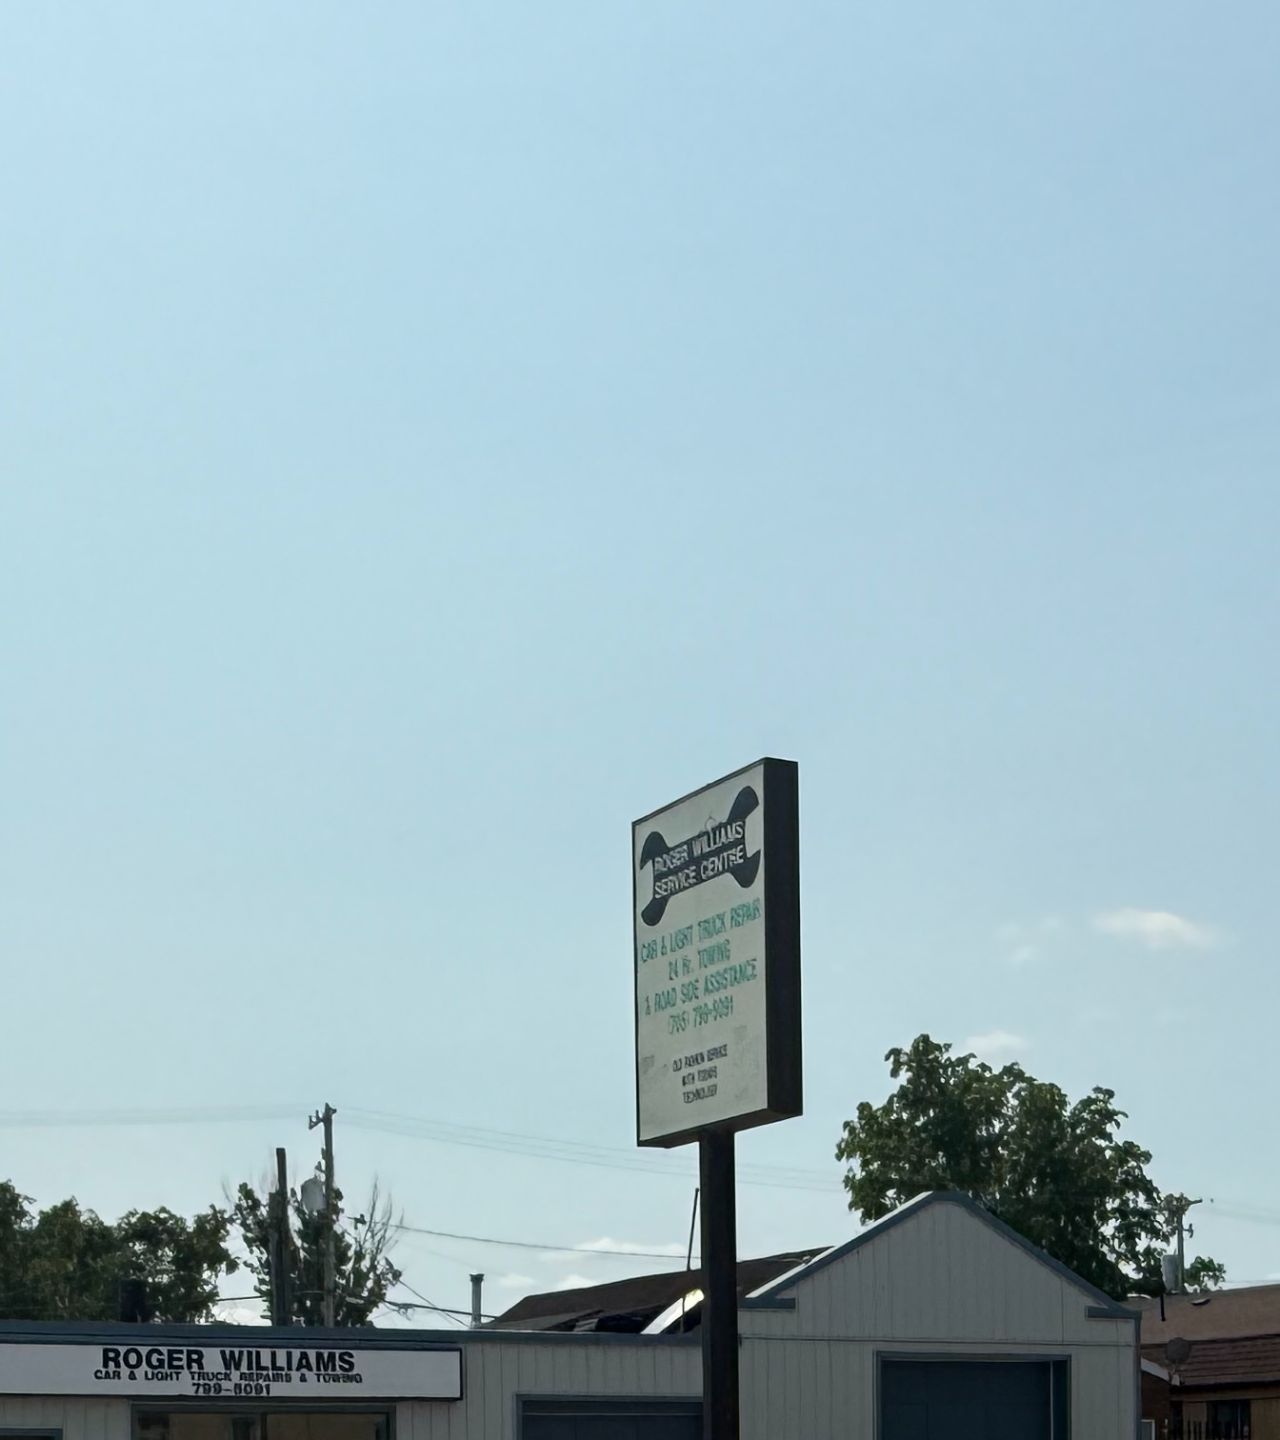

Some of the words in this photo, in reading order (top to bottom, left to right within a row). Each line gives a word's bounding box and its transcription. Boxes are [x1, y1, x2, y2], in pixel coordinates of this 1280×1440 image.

[692, 821, 745, 858] WILLIAMS
[654, 865, 697, 899] SERVICE
[701, 844, 745, 880] CENTRE
[698, 911, 727, 942] TRUCK
[654, 987, 677, 1012] ROAD
[681, 979, 699, 1004] SIDE
[703, 958, 757, 996] ASSISTANCE
[94, 1369, 122, 1381] CAR
[128, 1370, 138, 1381] &
[144, 1370, 182, 1382] LIGHT
[190, 1371, 233, 1382] TRUCK
[240, 1372, 292, 1383] REPAIRS
[299, 1373, 308, 1383] &
[316, 1373, 363, 1384] TOWING
[102, 1347, 205, 1370] ROGER
[220, 1350, 356, 1373] WILLIAMS
